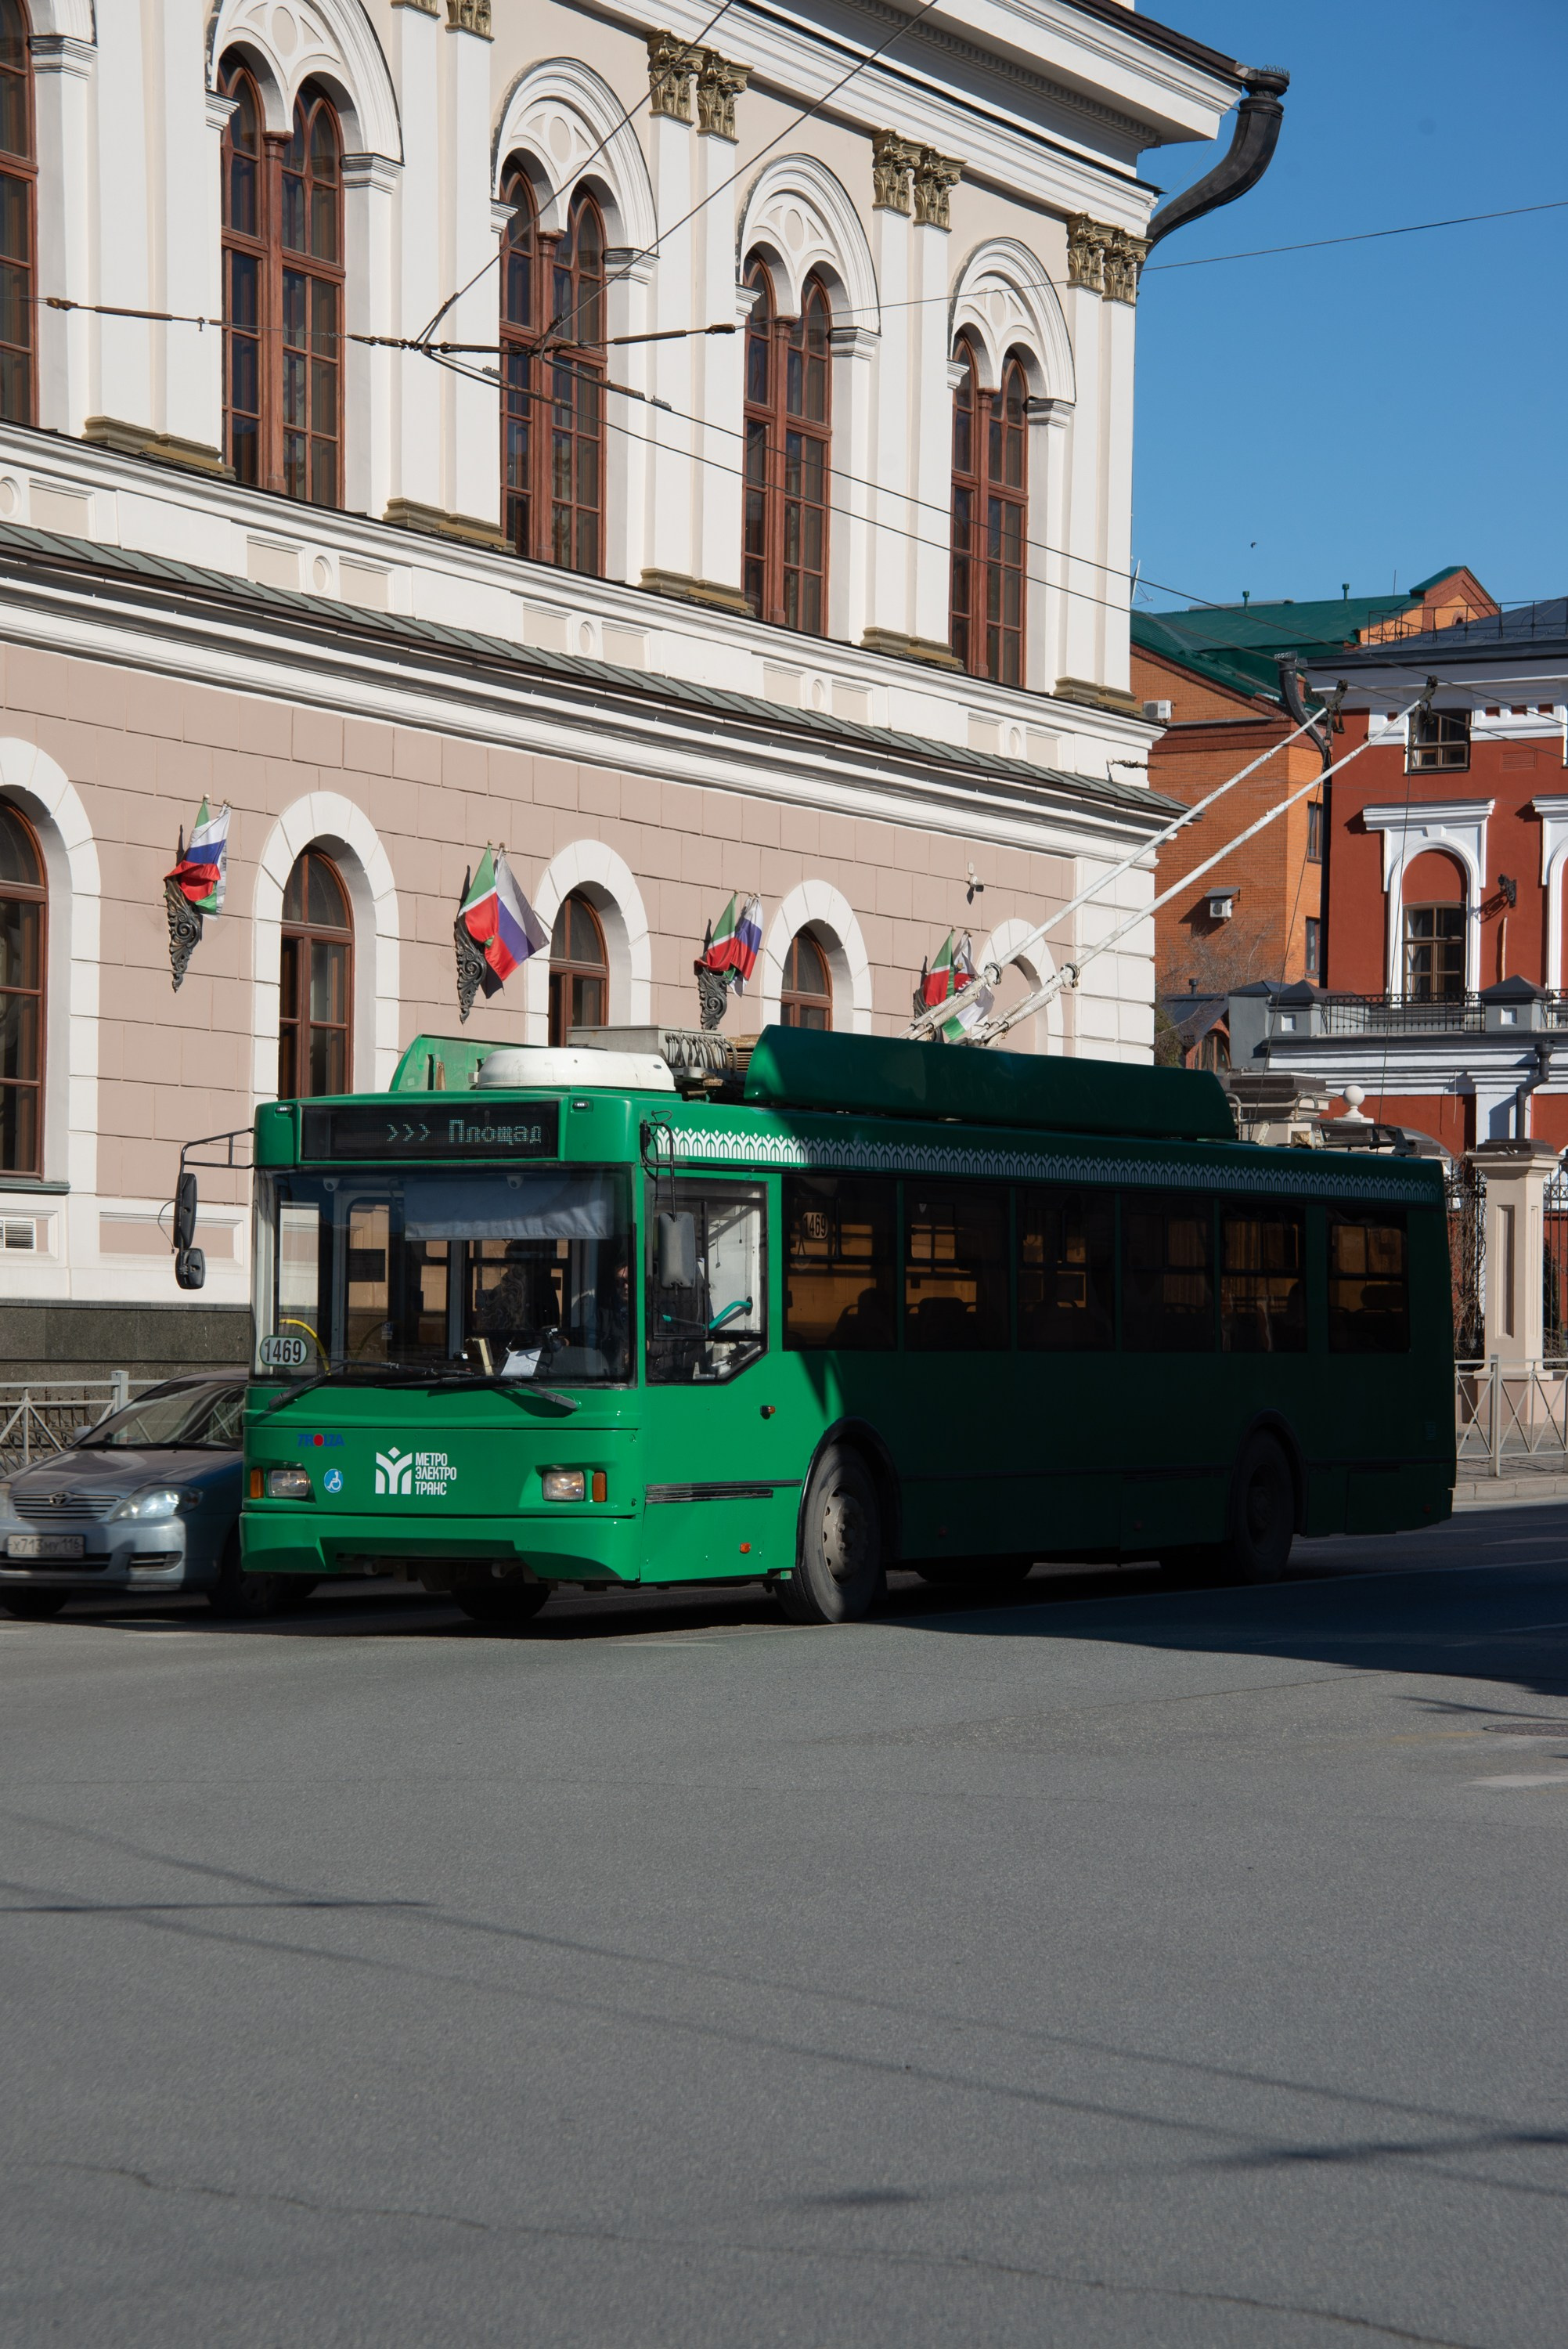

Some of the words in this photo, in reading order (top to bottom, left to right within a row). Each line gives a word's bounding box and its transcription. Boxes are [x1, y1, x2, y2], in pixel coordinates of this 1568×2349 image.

[449, 1120, 541, 1145] Площад
[804, 1214, 826, 1236] 1469
[265, 1339, 301, 1363] 1469
[415, 1452, 448, 1467] МЕТРО
[415, 1466, 456, 1480] ЭЛЕКТРО
[415, 1481, 447, 1496] ТРАНС
